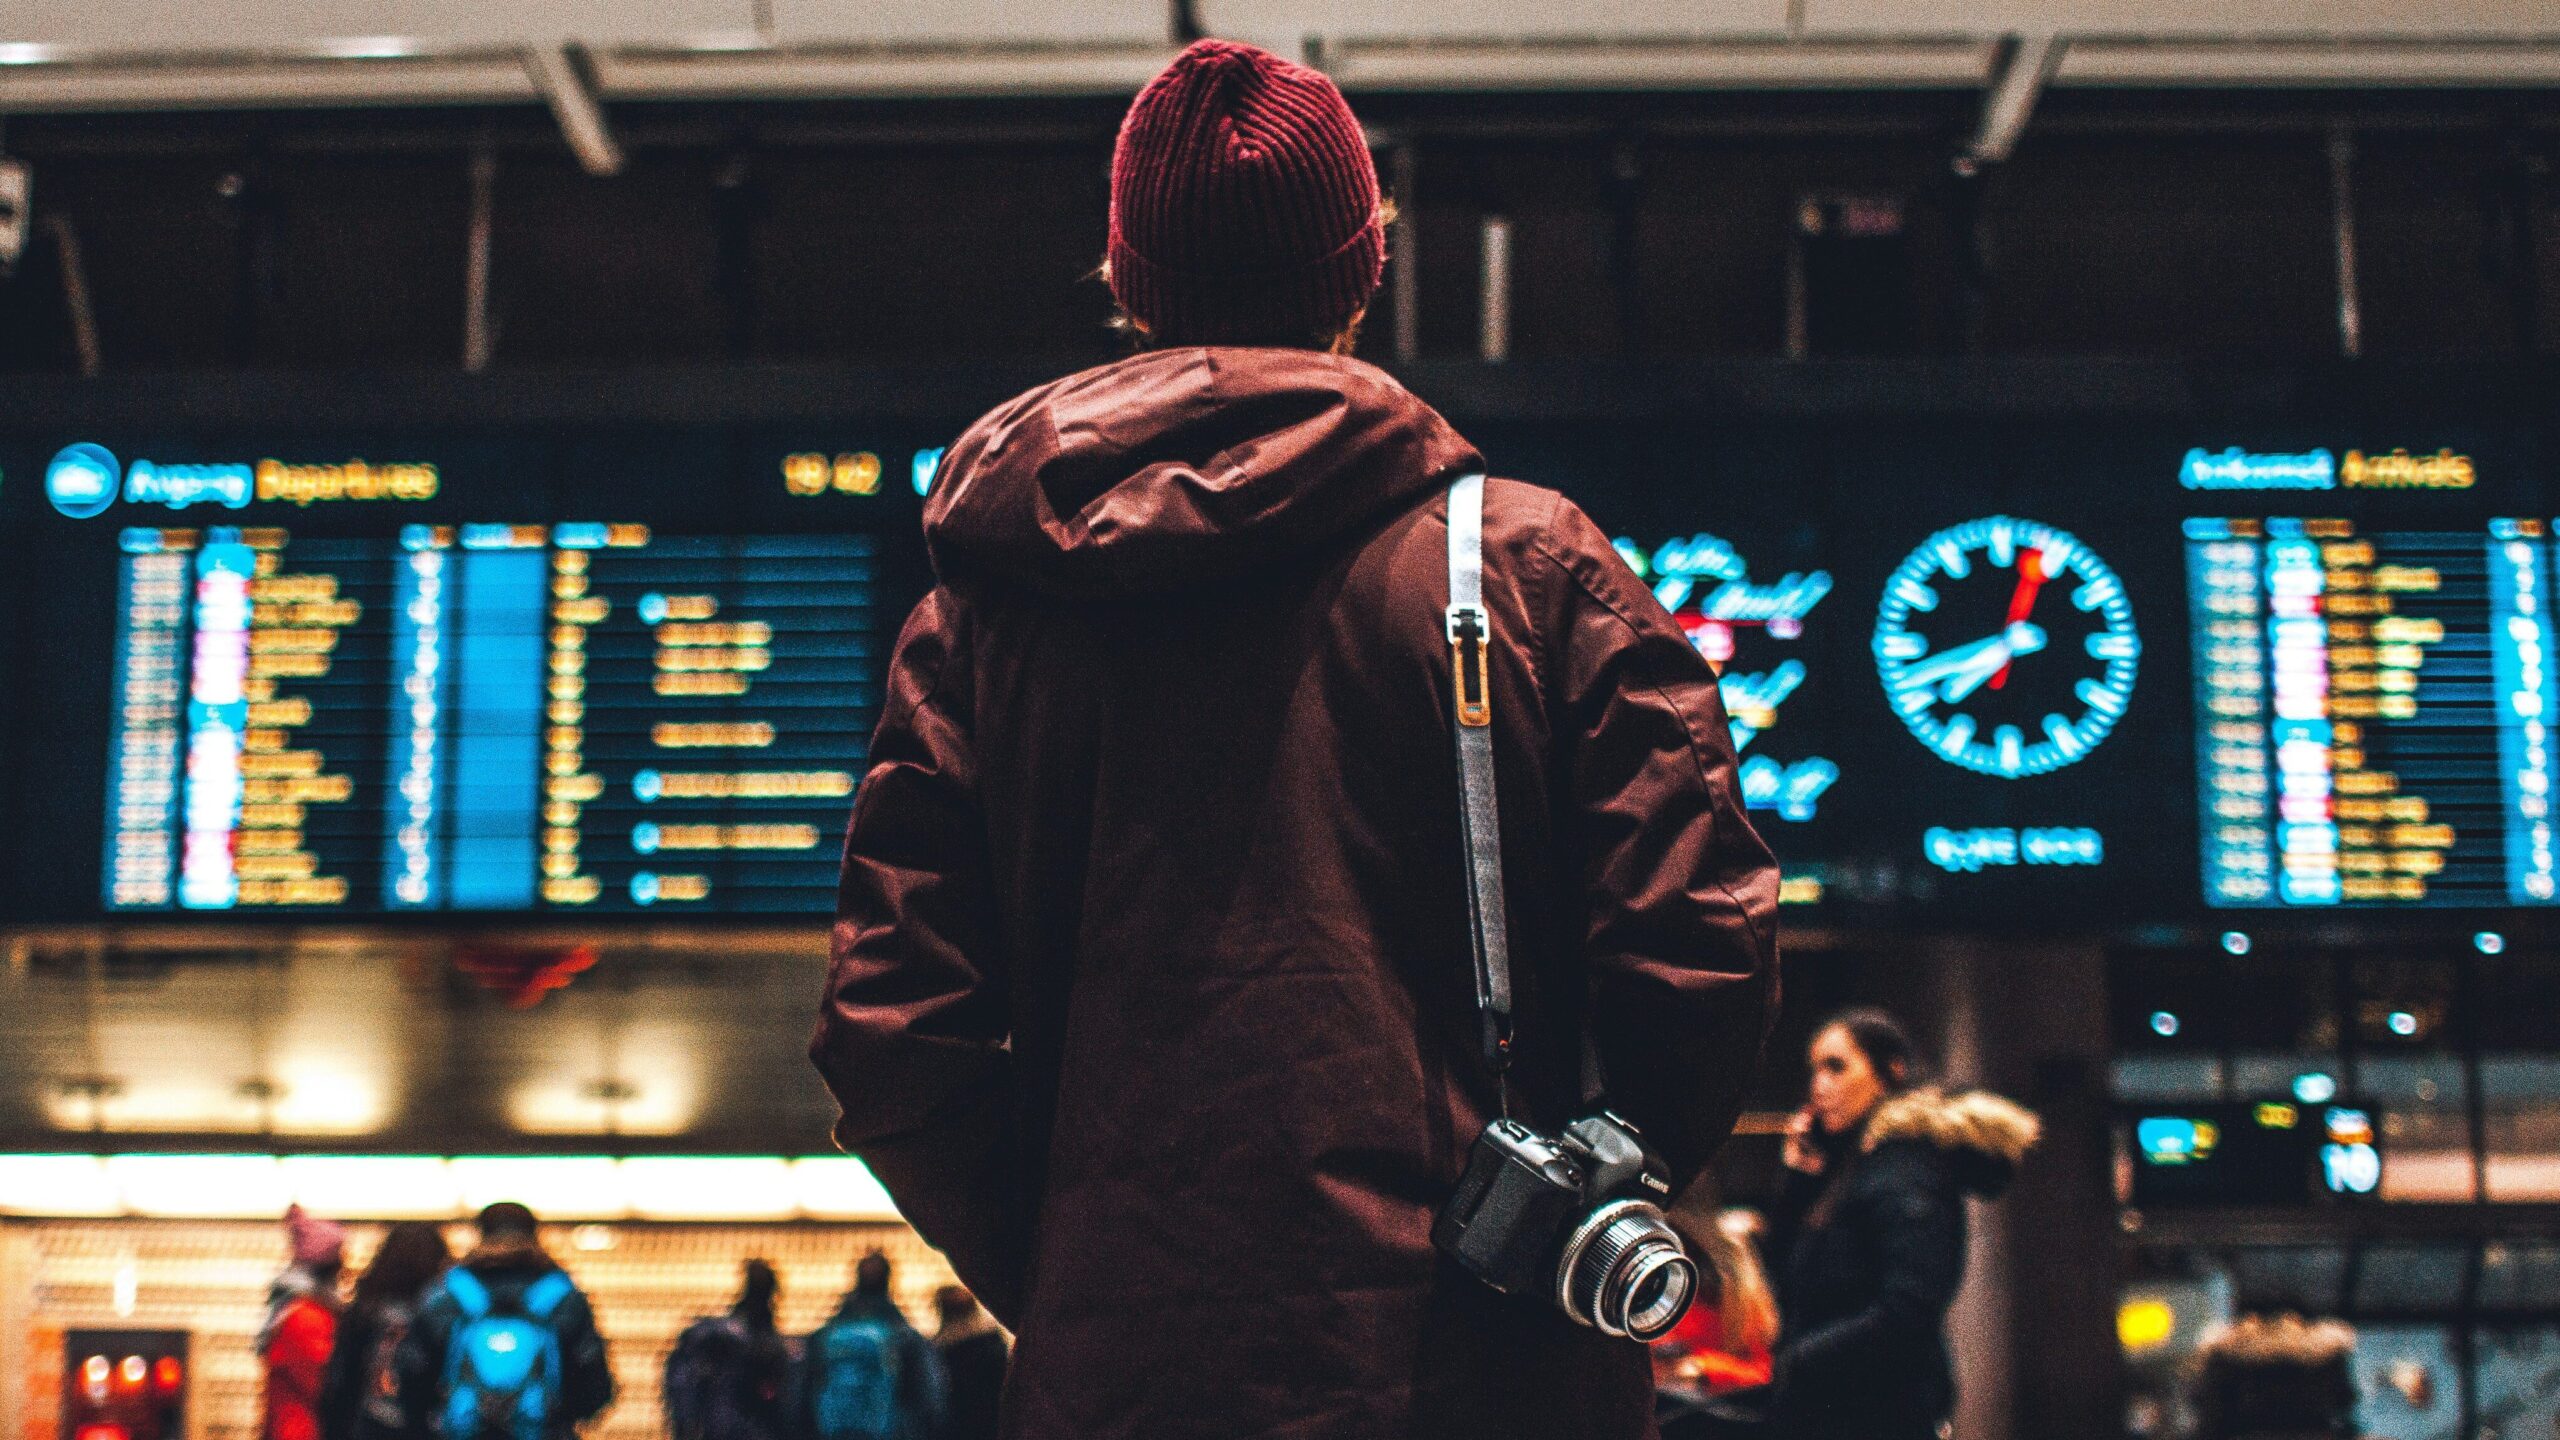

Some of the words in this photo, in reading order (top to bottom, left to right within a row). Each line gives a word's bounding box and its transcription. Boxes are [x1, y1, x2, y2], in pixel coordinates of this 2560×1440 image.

[257, 459, 438, 505] Departures
[2342, 449, 2475, 487] Arrivals
[1640, 1172, 1670, 1195] Canon
